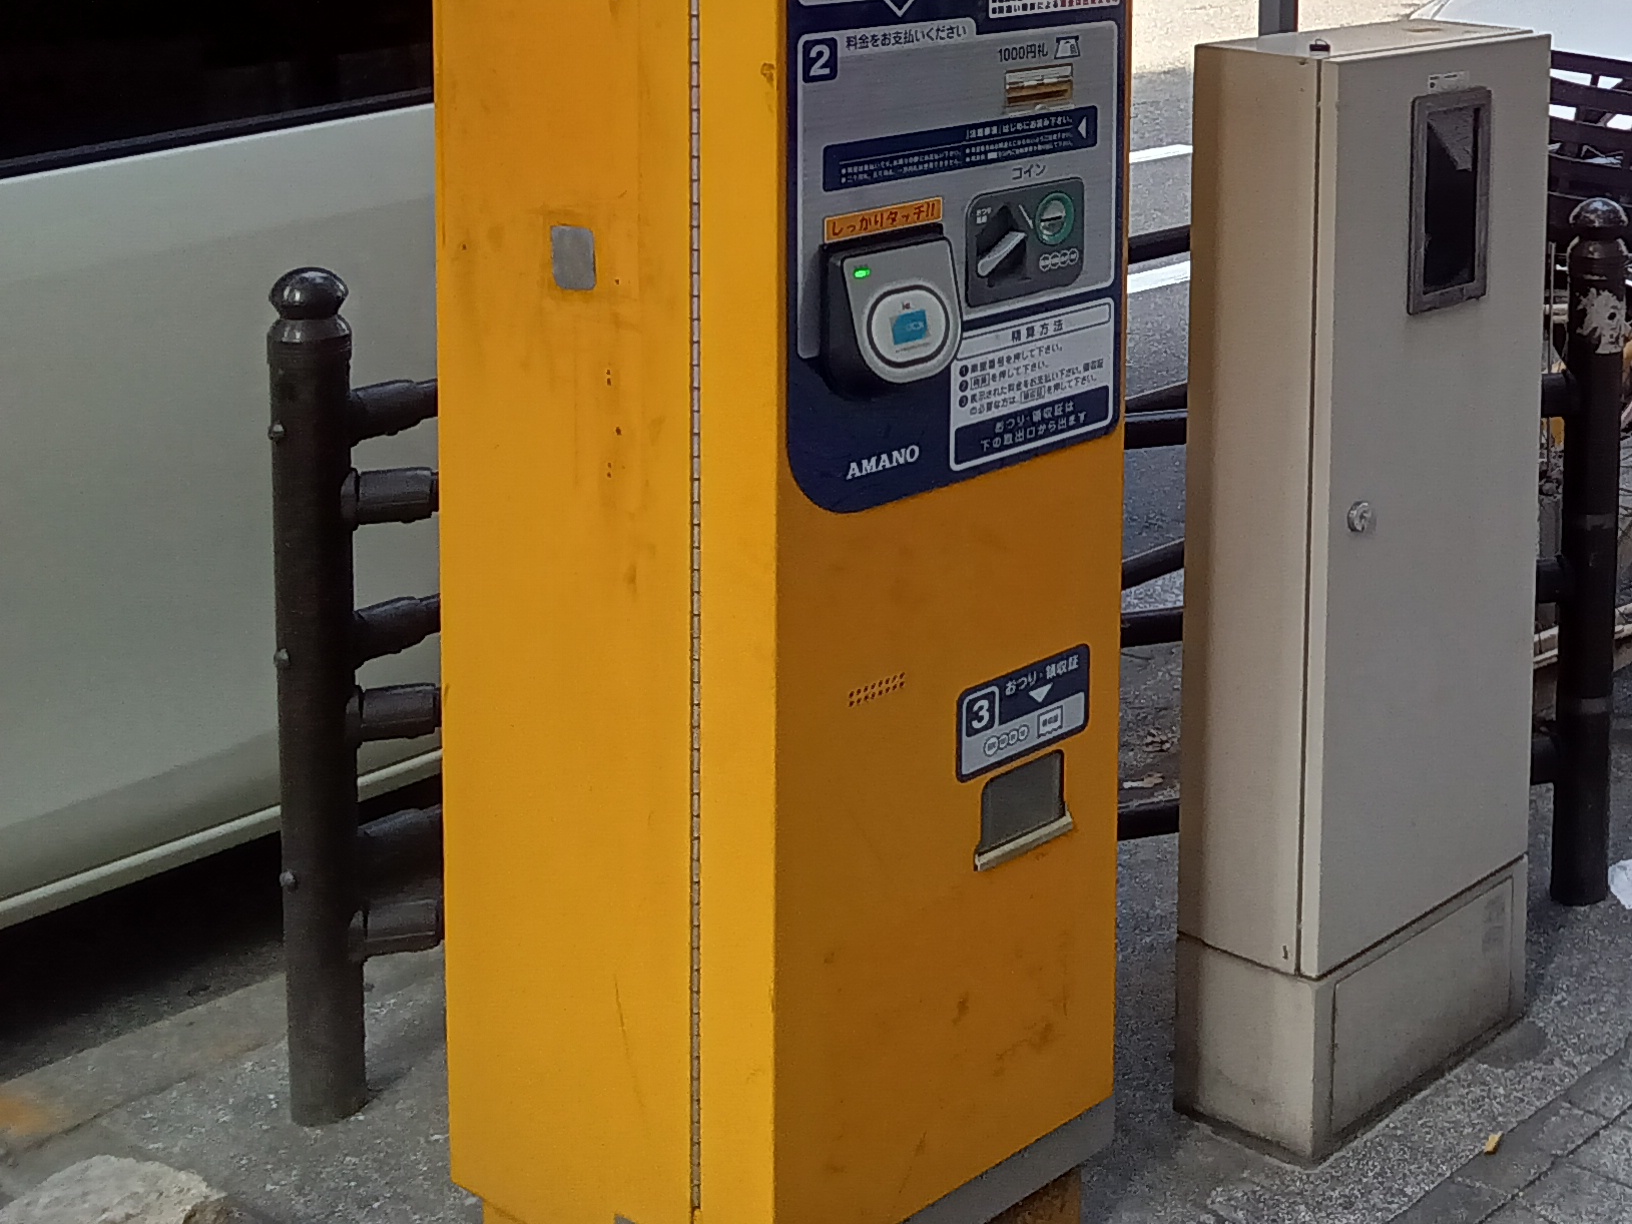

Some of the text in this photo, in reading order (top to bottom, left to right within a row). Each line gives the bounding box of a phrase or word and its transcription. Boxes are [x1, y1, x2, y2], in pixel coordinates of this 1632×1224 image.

[845, 26, 967, 51] 料金をお支払いください
[999, 42, 1049, 62] 1000円札
[809, 44, 831, 77] 2
[1012, 163, 1047, 181] コイン
[845, 444, 920, 480] AMANO
[971, 699, 990, 729] 3
